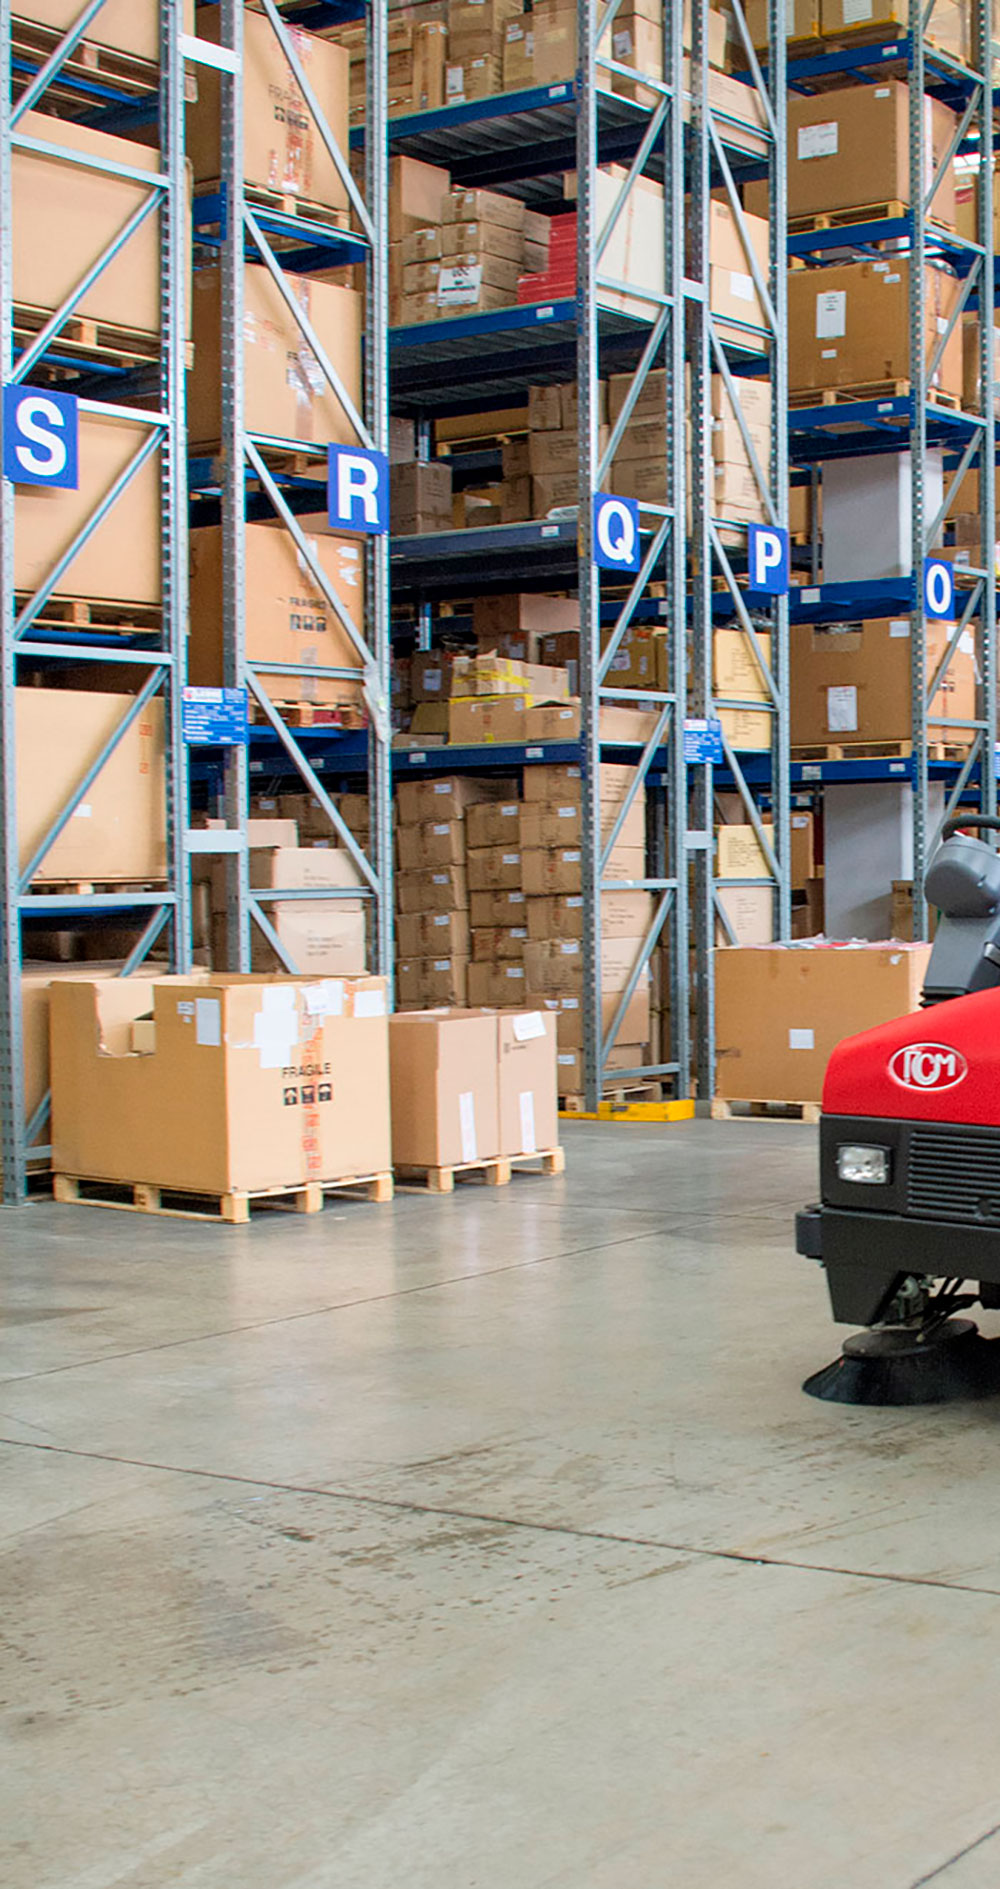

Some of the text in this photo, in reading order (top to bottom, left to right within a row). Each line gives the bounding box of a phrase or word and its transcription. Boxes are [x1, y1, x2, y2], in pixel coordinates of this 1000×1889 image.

[15, 396, 67, 476] S
[337, 453, 380, 524] R
[597, 500, 634, 565] Q
[755, 531, 783, 584] P
[928, 563, 952, 614] O
[282, 1062, 332, 1079] FRAGILE
